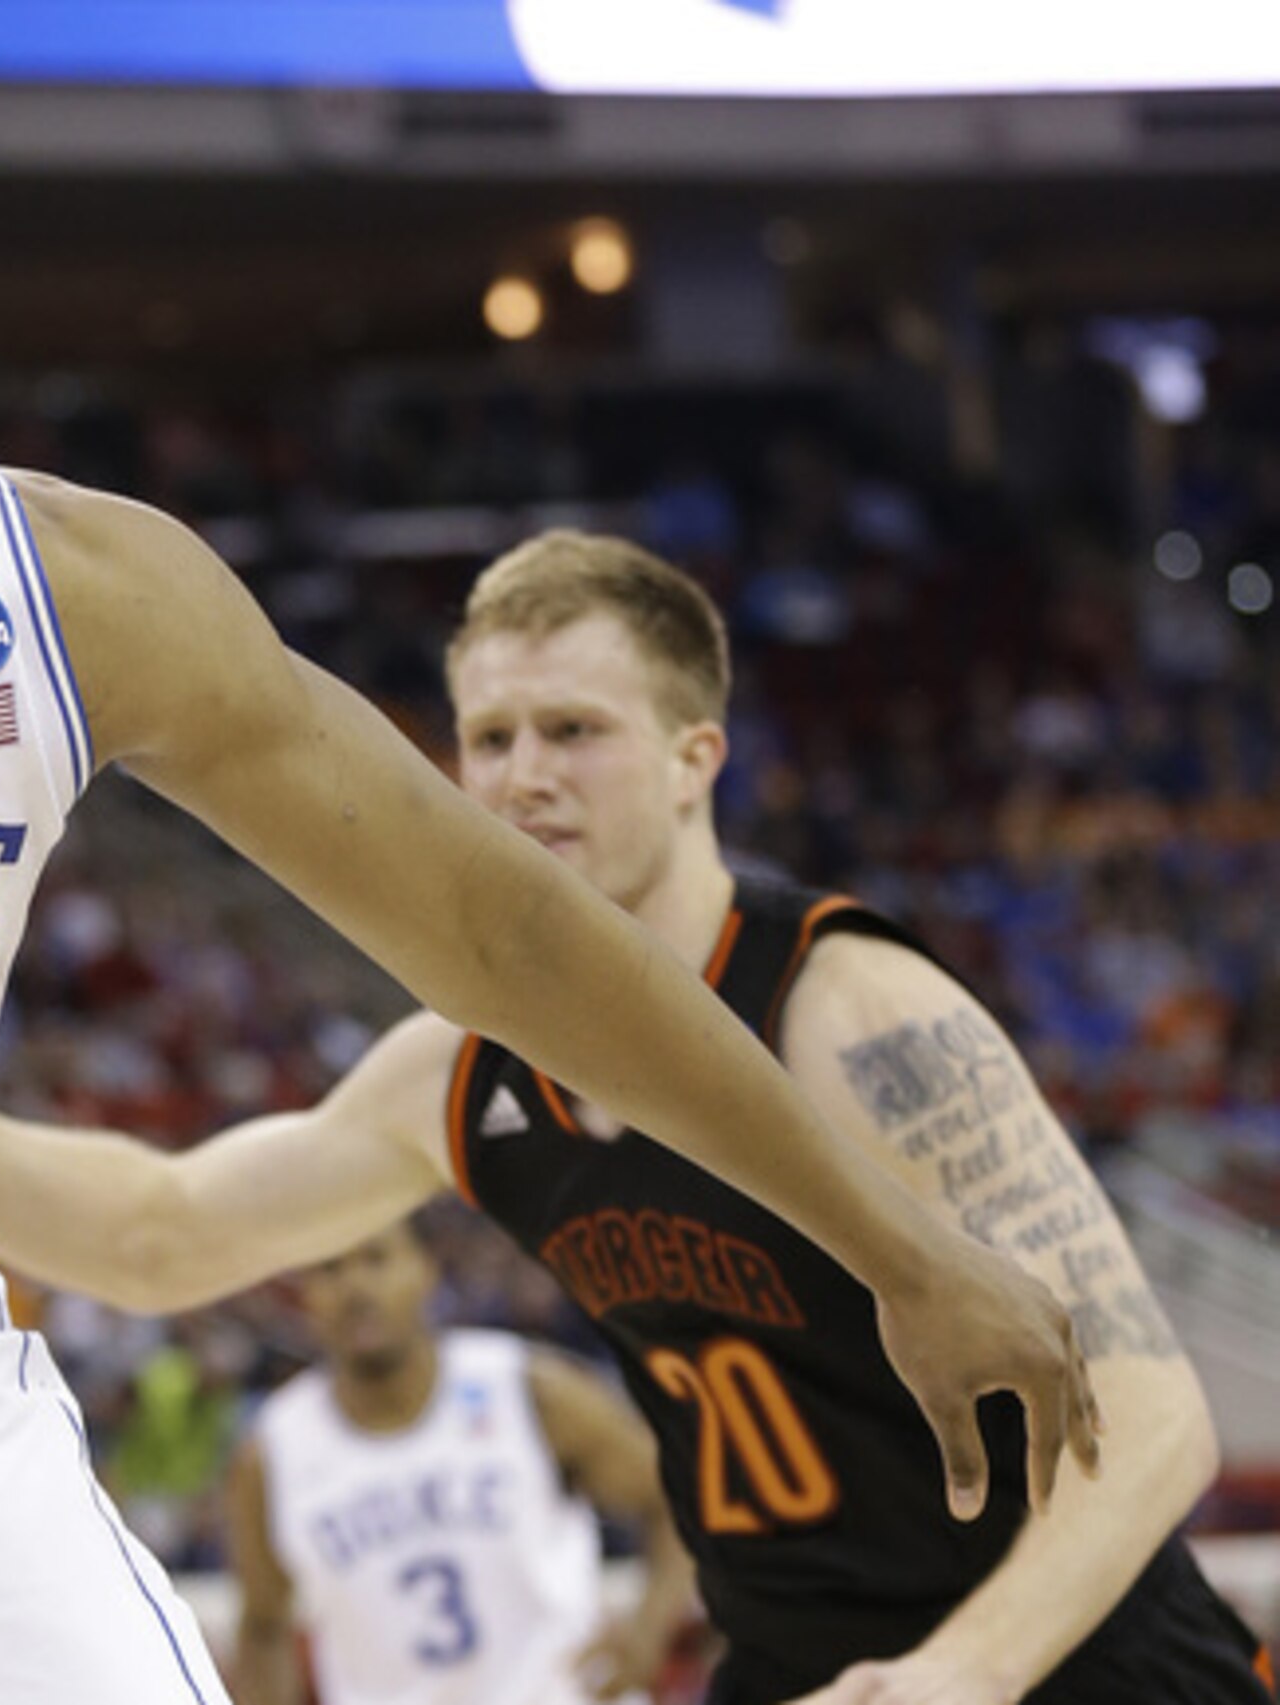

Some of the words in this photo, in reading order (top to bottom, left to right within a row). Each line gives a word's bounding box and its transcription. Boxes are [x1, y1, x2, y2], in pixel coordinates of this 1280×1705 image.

[539, 1206, 807, 1330] ERCER
[645, 1338, 839, 1533] 20
[396, 1553, 480, 1668] 3
